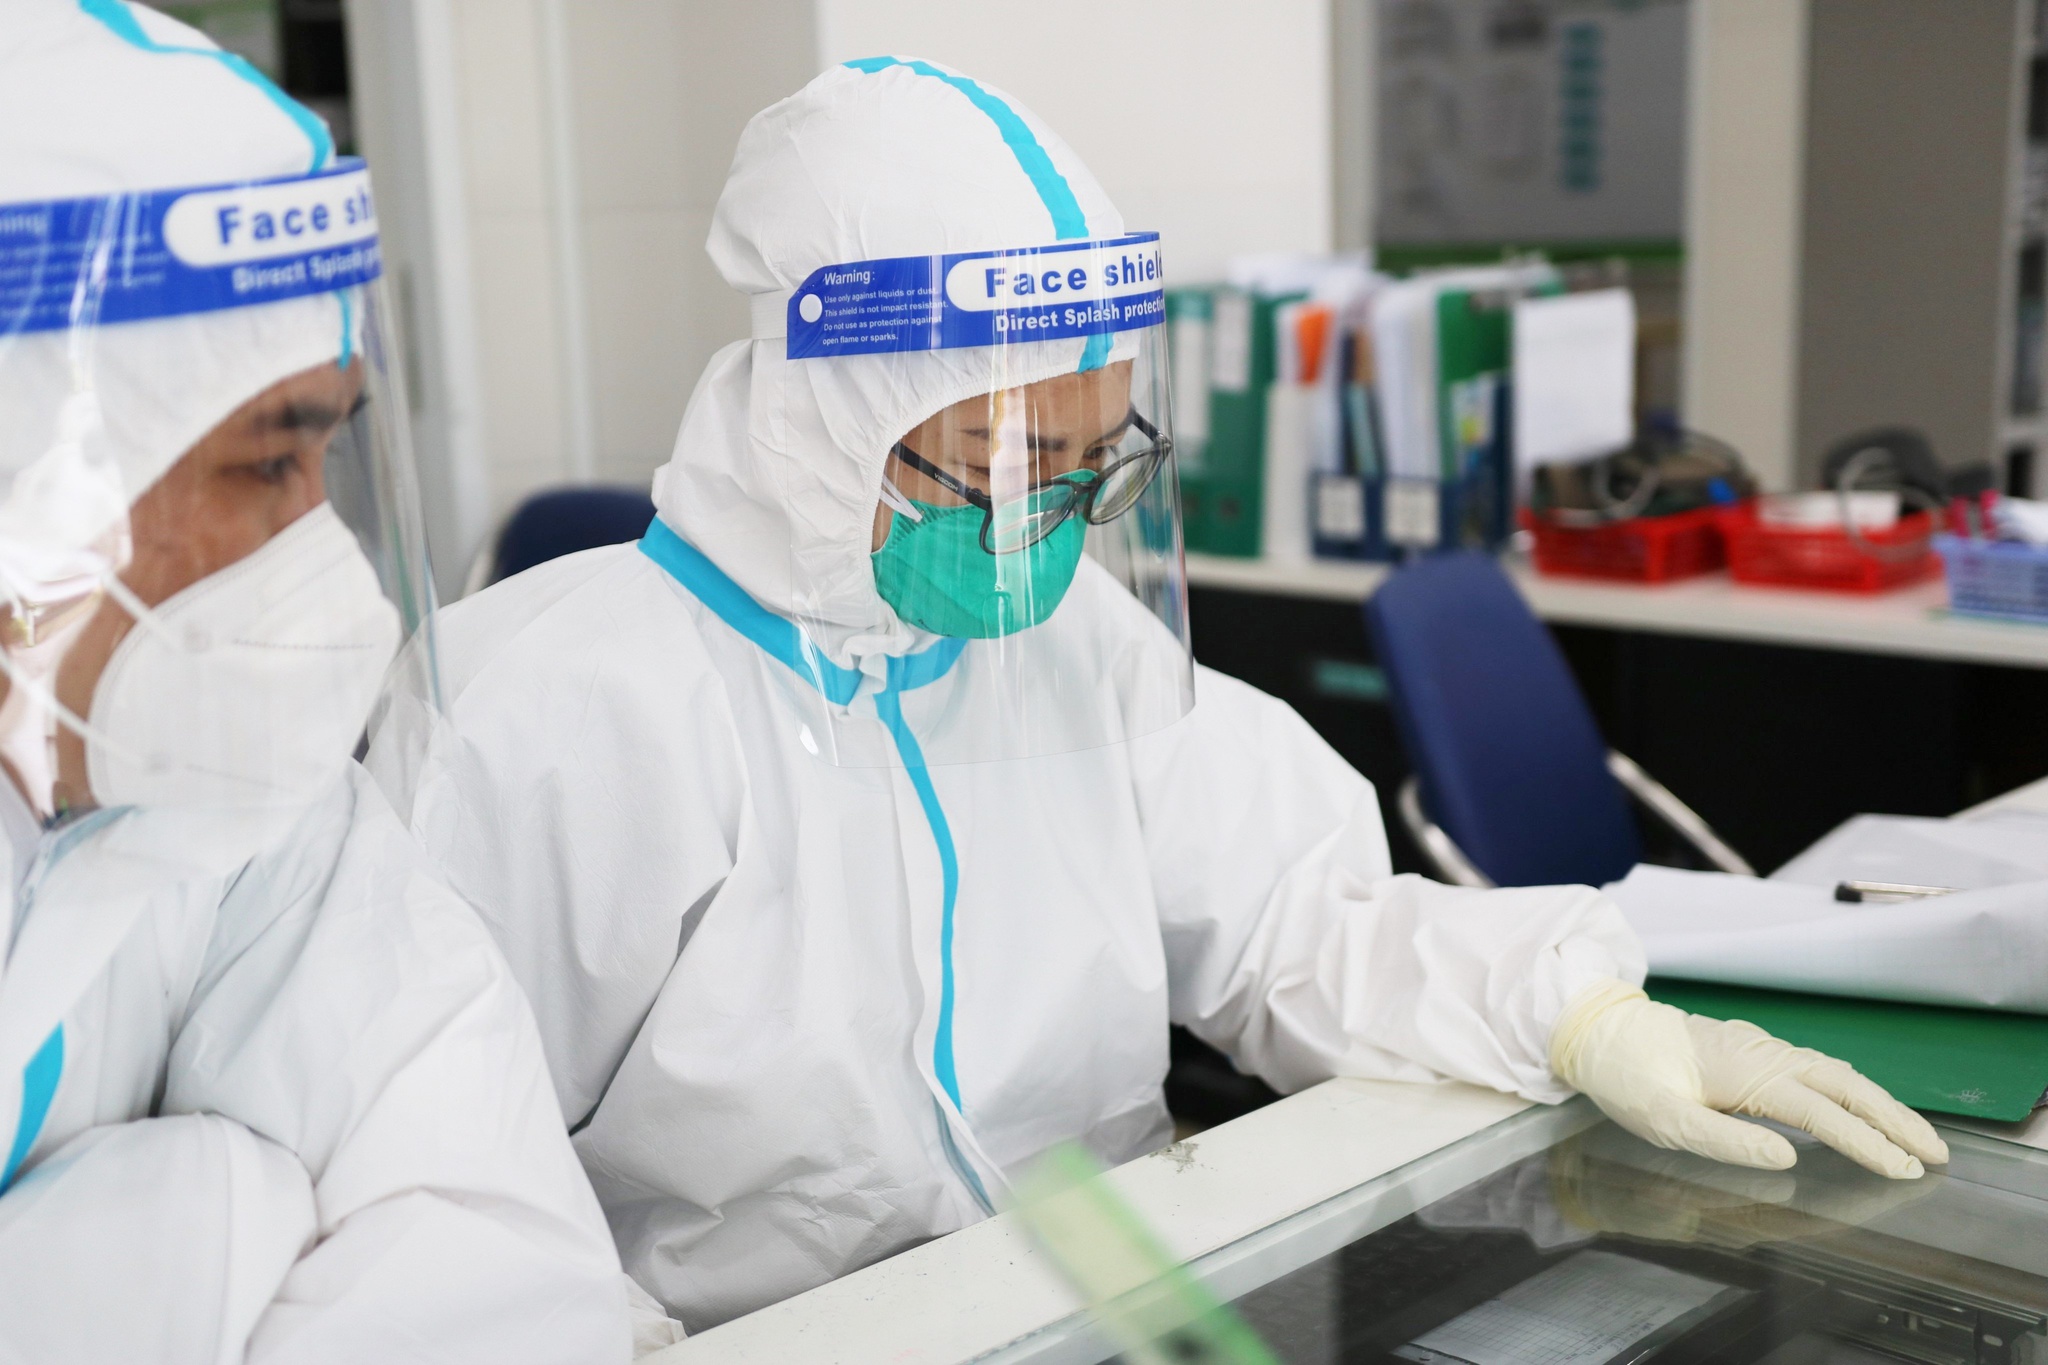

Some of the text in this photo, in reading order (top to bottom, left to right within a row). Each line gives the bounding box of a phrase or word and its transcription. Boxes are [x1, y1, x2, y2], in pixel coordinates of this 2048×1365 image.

[216, 203, 329, 246] Face
[985, 267, 1088, 298] Face
[824, 295, 837, 304] Use
[838, 294, 850, 303] only
[852, 290, 877, 302] against
[878, 289, 904, 299] liquids
[906, 288, 915, 296] or
[825, 300, 949, 318] This shield is not impact resistant.
[995, 311, 1058, 332] Direct
[1064, 303, 1120, 328] Splash
[823, 316, 942, 331] Do not use as protection against
[822, 337, 839, 346] open
[840, 335, 859, 343] flame
[870, 333, 899, 343] sparks.
